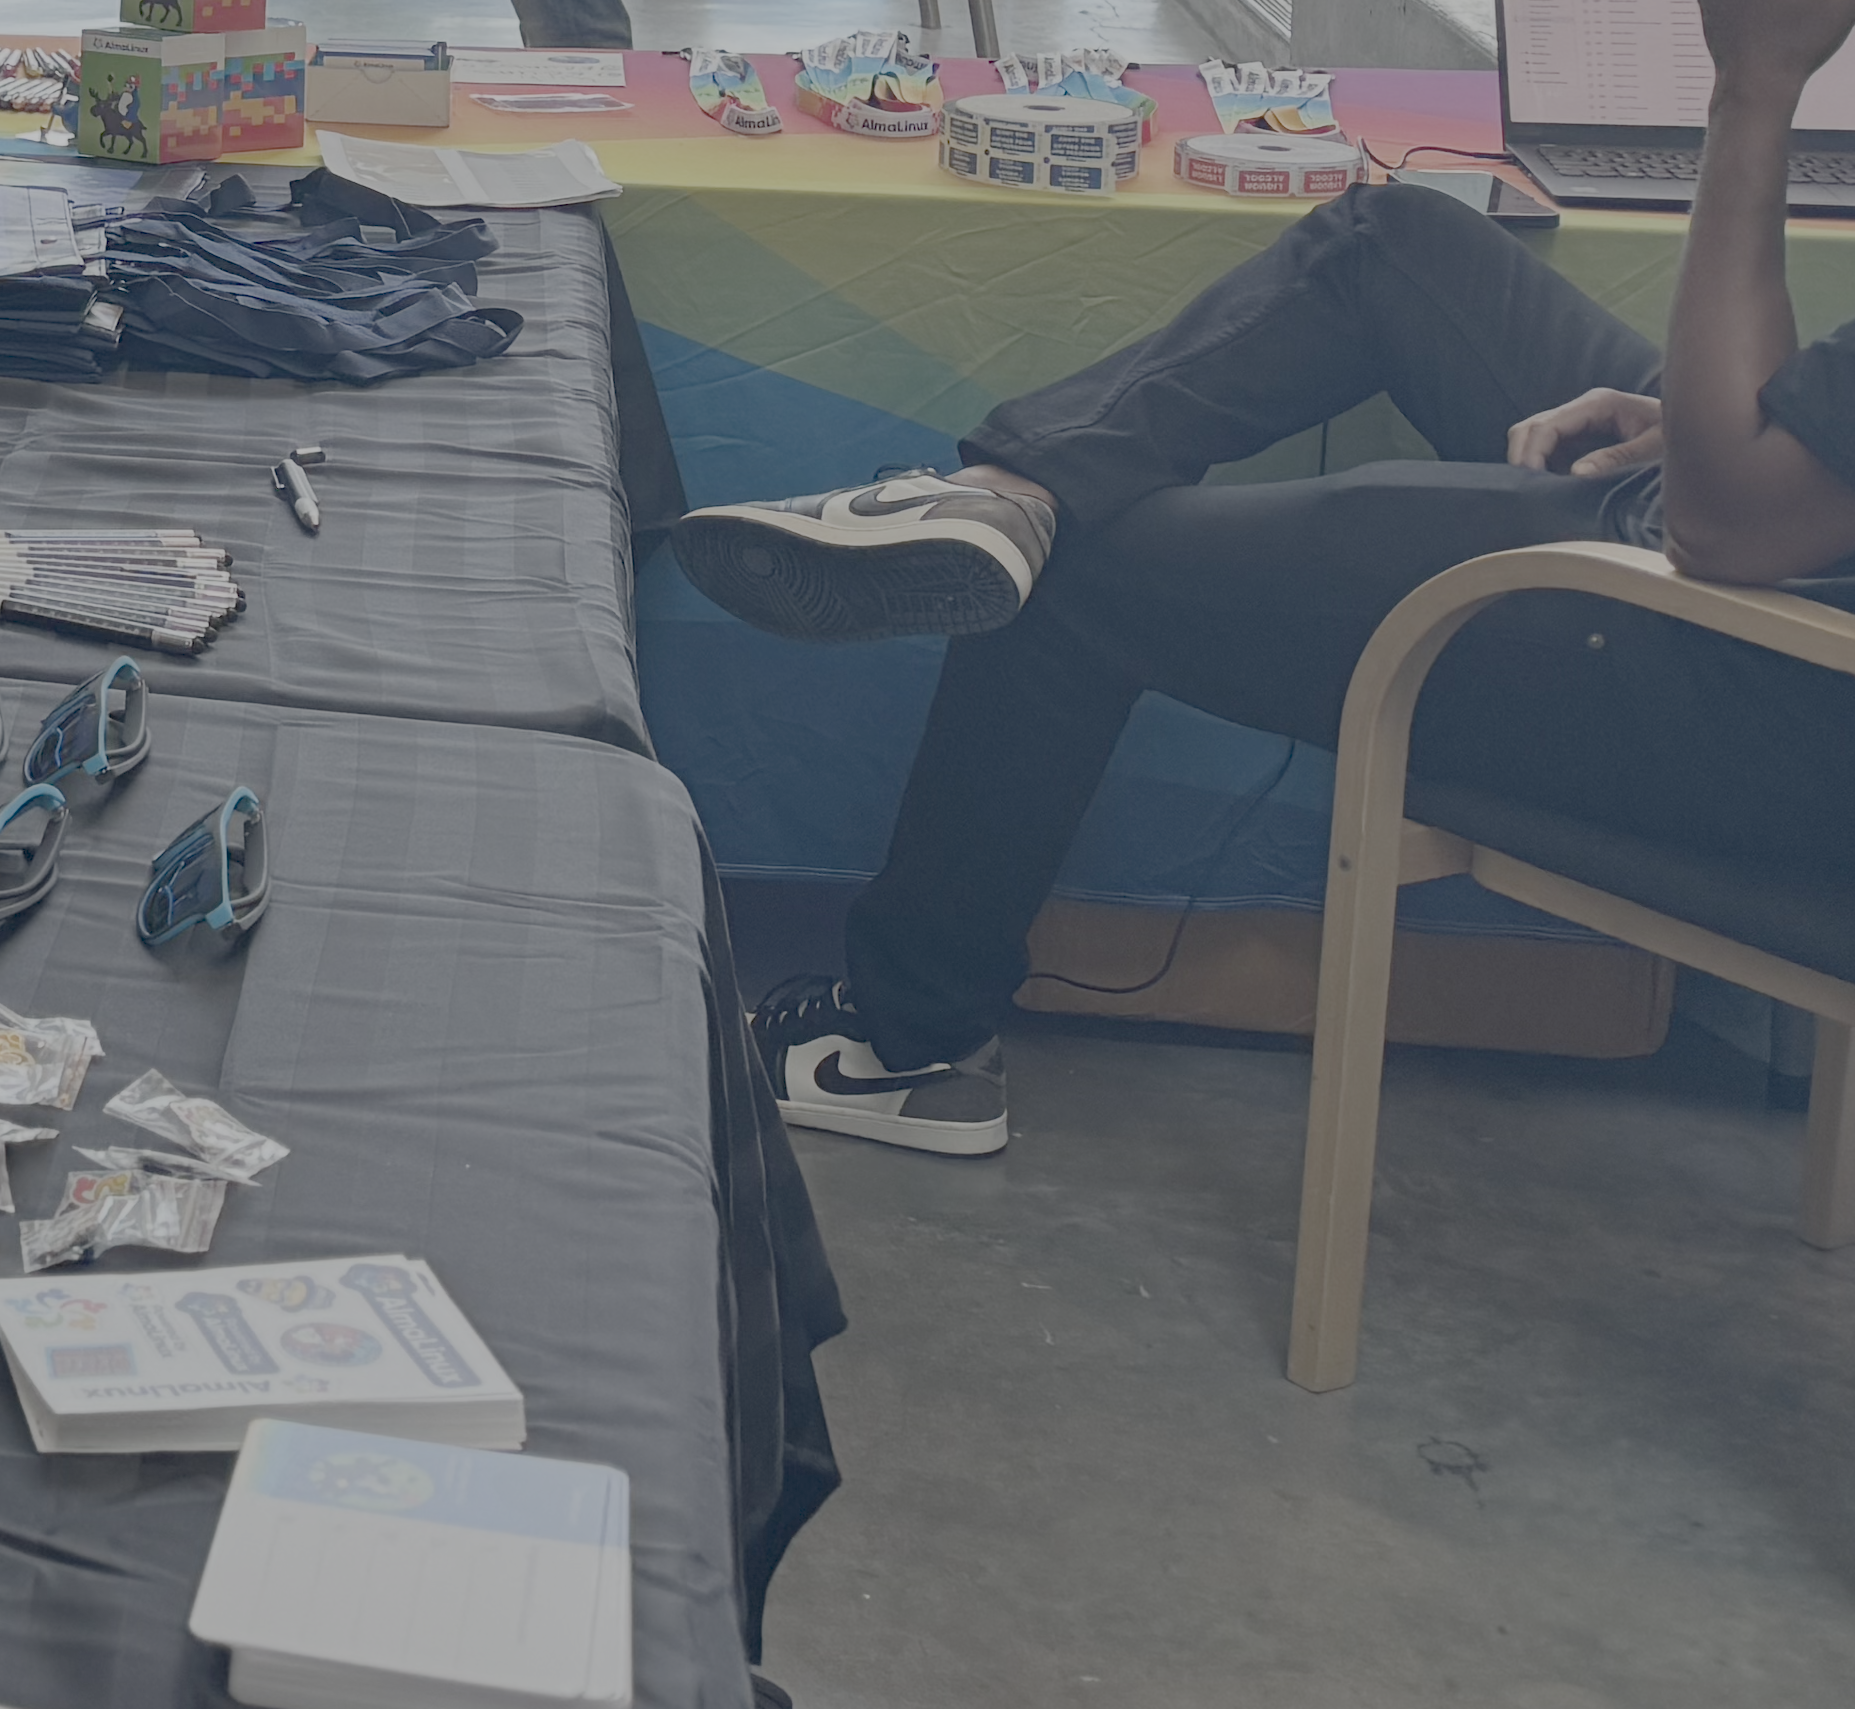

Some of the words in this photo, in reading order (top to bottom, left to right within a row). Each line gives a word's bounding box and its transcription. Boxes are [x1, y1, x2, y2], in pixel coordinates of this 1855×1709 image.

[103, 40, 148, 54] AlmaLinux
[861, 117, 929, 133] AlmaLinux
[374, 1296, 463, 1385] AlmaLinux
[86, 1379, 271, 1399] AlmaLinux
